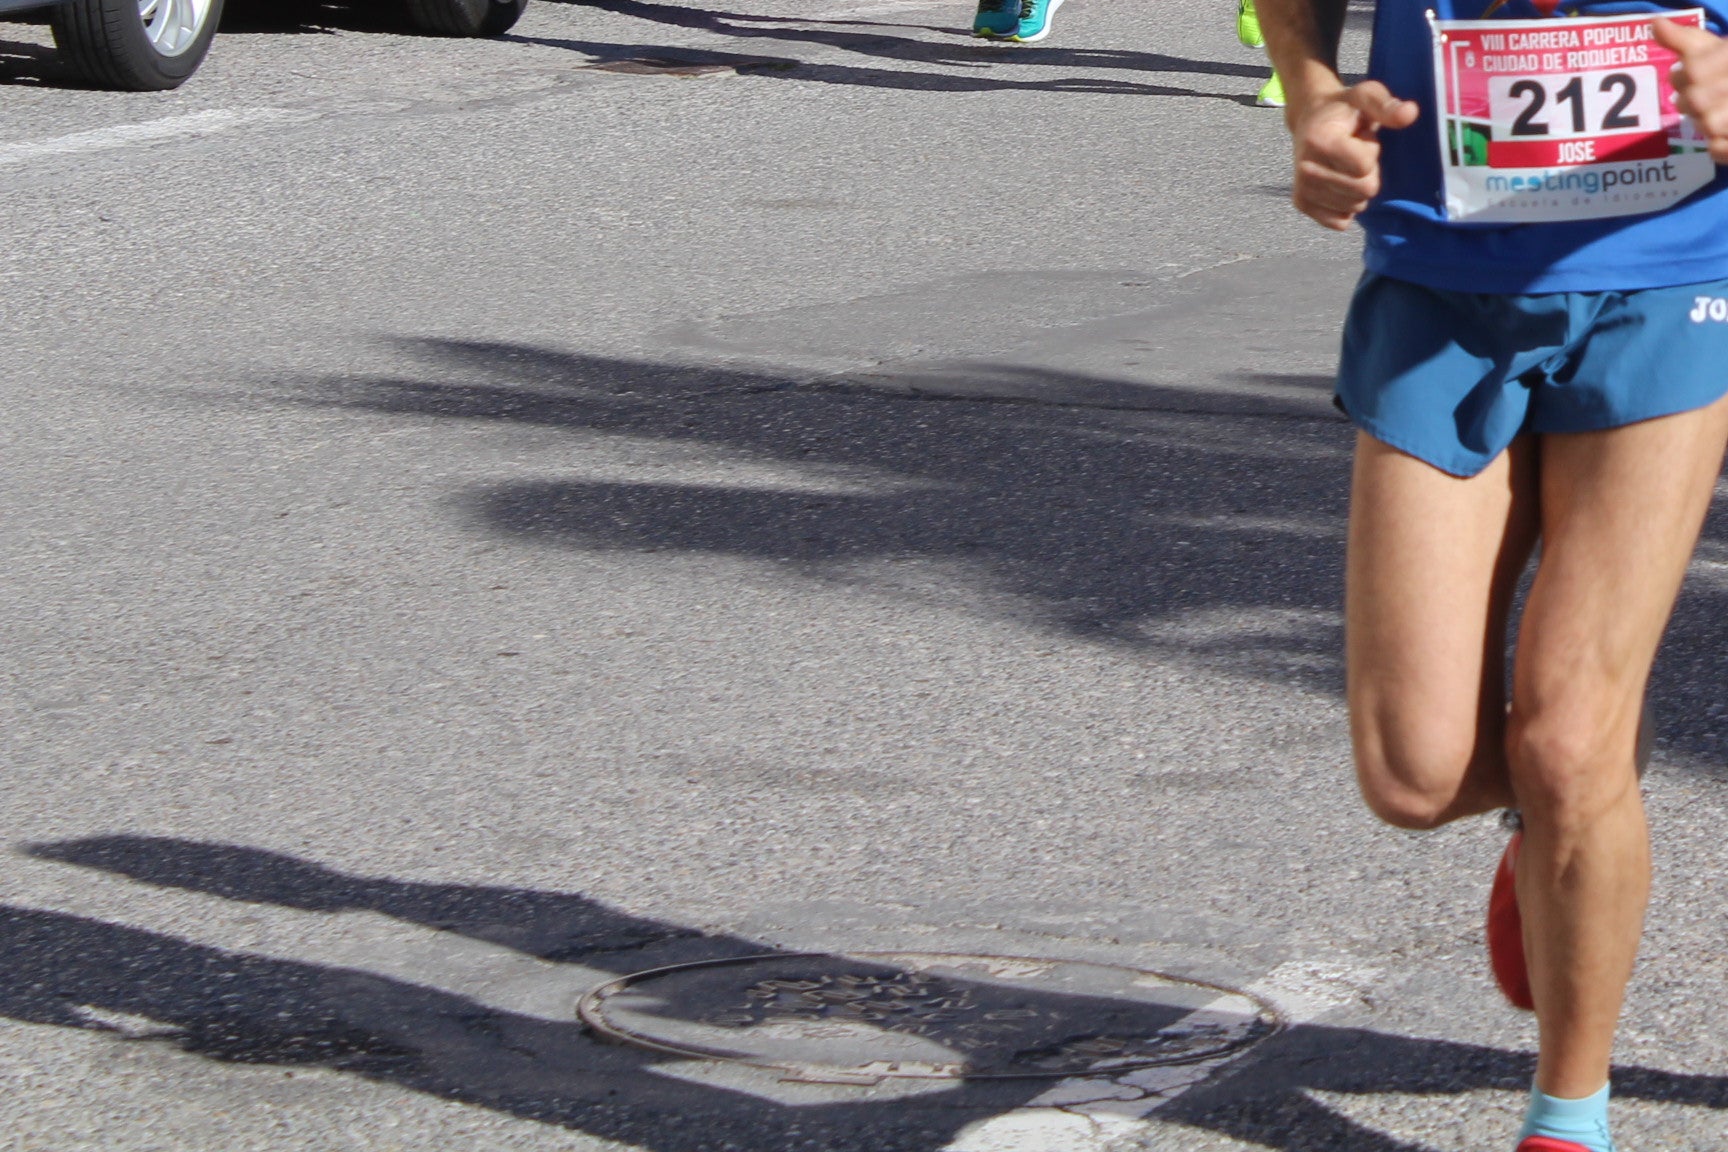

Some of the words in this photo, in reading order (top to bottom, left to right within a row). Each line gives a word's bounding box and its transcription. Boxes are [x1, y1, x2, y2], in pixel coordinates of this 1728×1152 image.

[1480, 34, 1505, 52] VIII
[1508, 31, 1580, 51] CARRERA
[1583, 23, 1654, 47] POPULAR
[1483, 52, 1539, 72] CIUDAD
[1543, 51, 1564, 70] DE
[1566, 43, 1649, 69] ROQUETAS
[1508, 72, 1641, 136] 212
[1556, 139, 1596, 164] JOSE
[1485, 160, 1678, 193] meetingpoint
